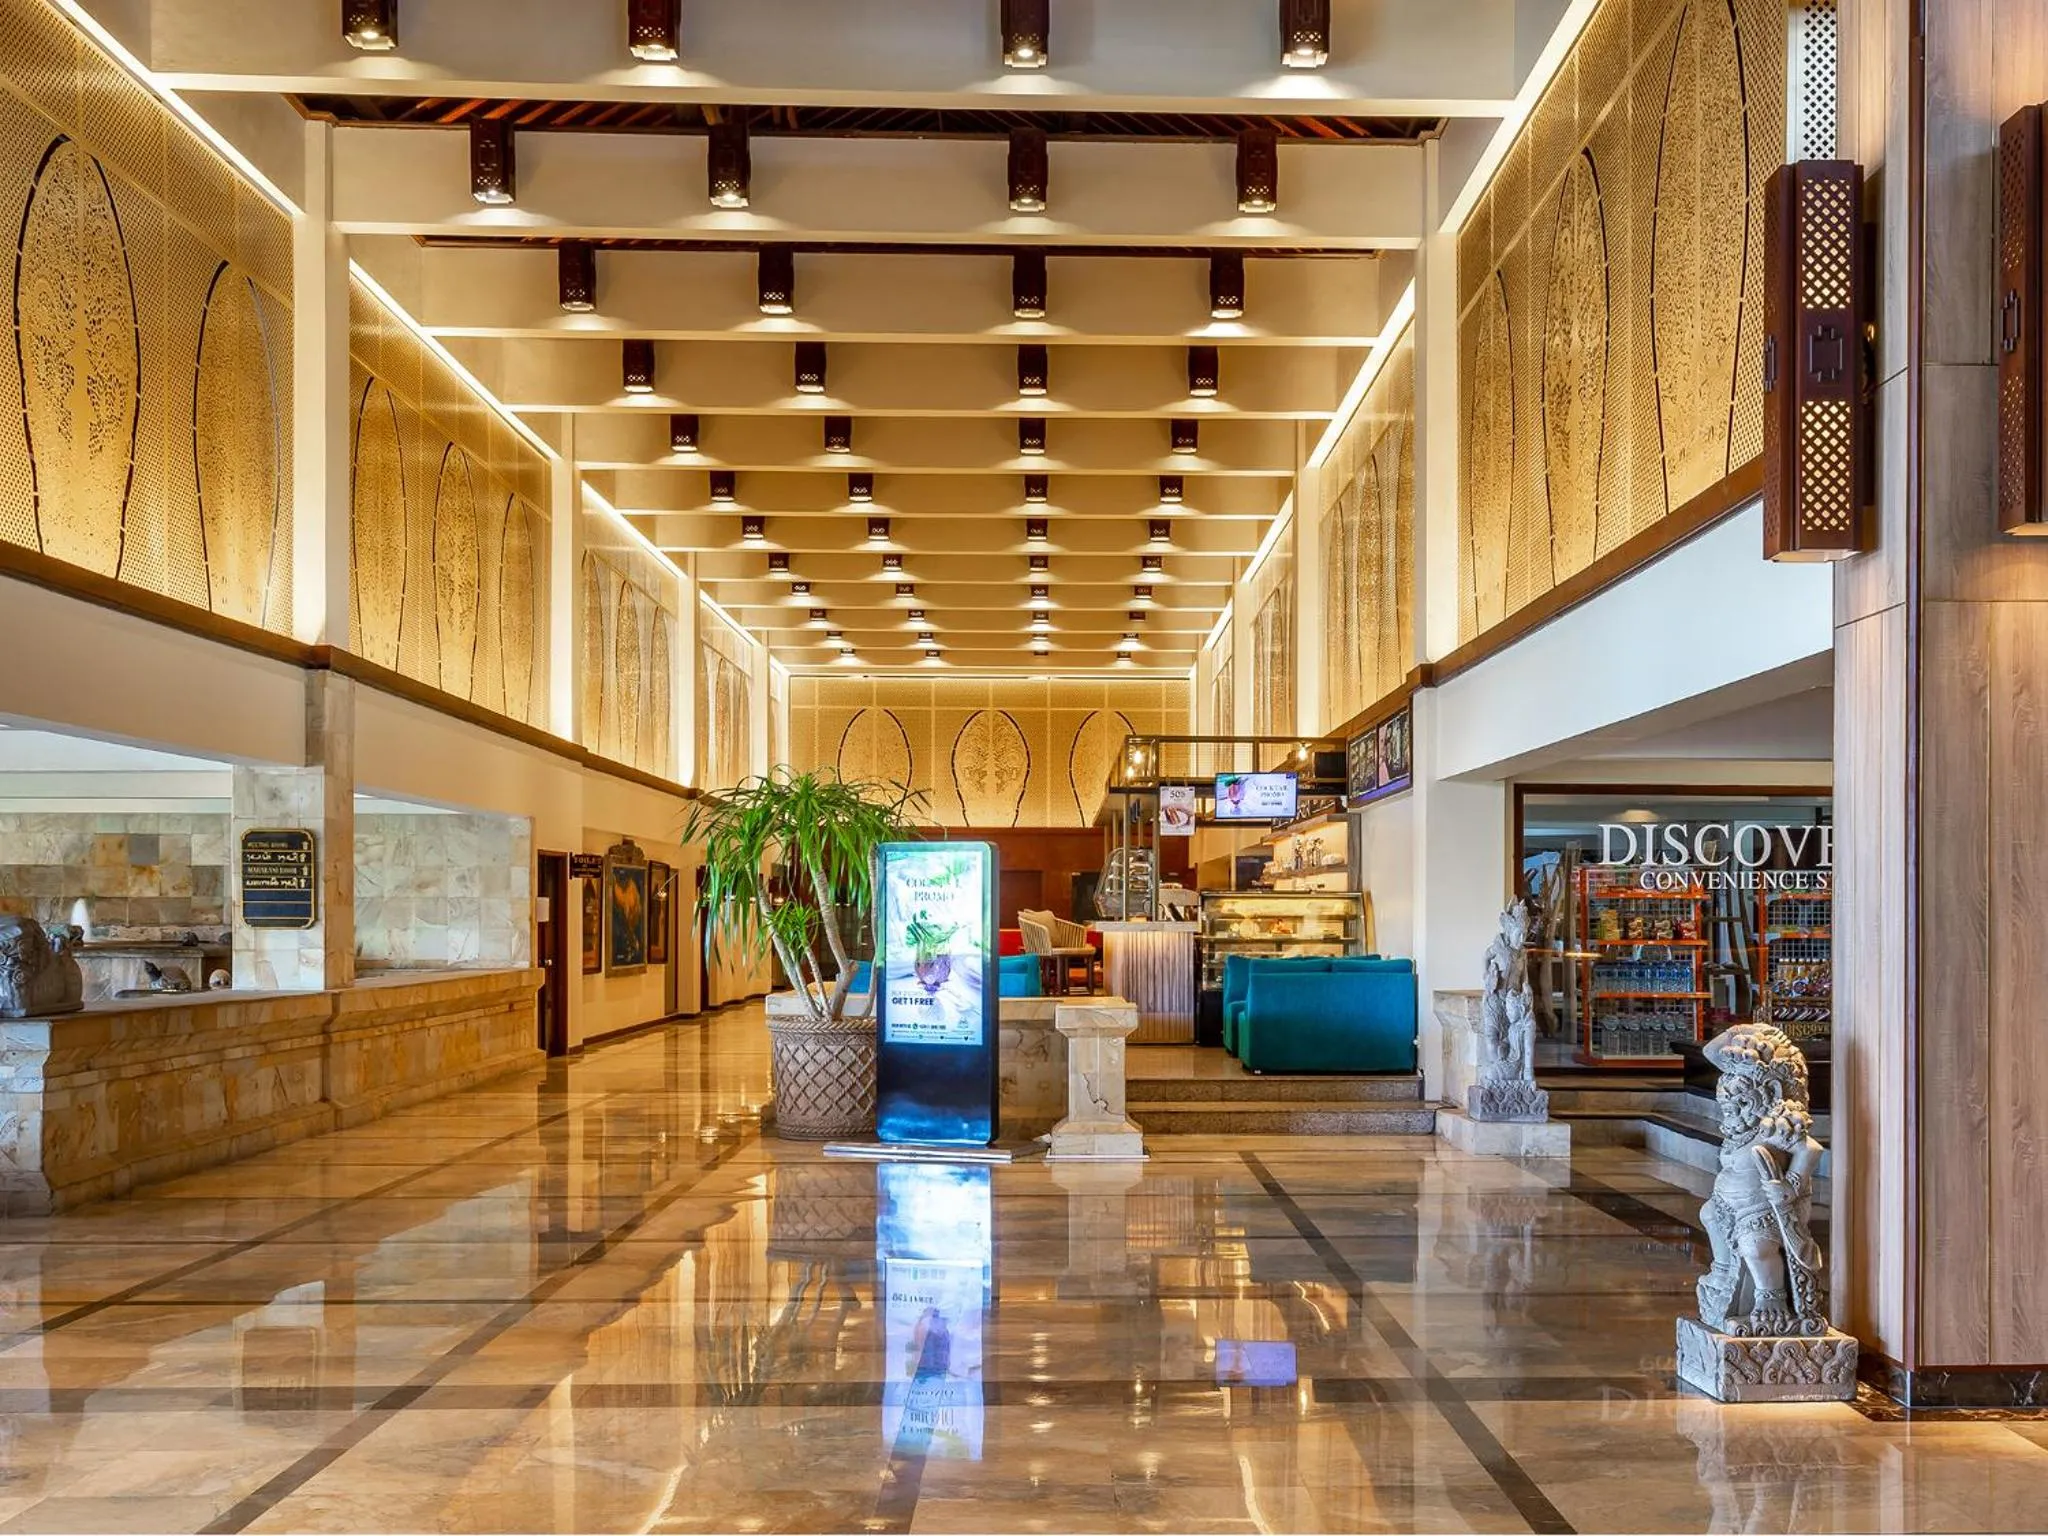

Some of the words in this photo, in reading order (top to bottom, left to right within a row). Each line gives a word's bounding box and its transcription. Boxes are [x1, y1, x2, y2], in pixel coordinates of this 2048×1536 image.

[1640, 871, 1808, 891] CONVENIENCE
[914, 891, 955, 902] PROMO
[892, 997, 908, 1006] GET
[915, 998, 935, 1006] FREE
